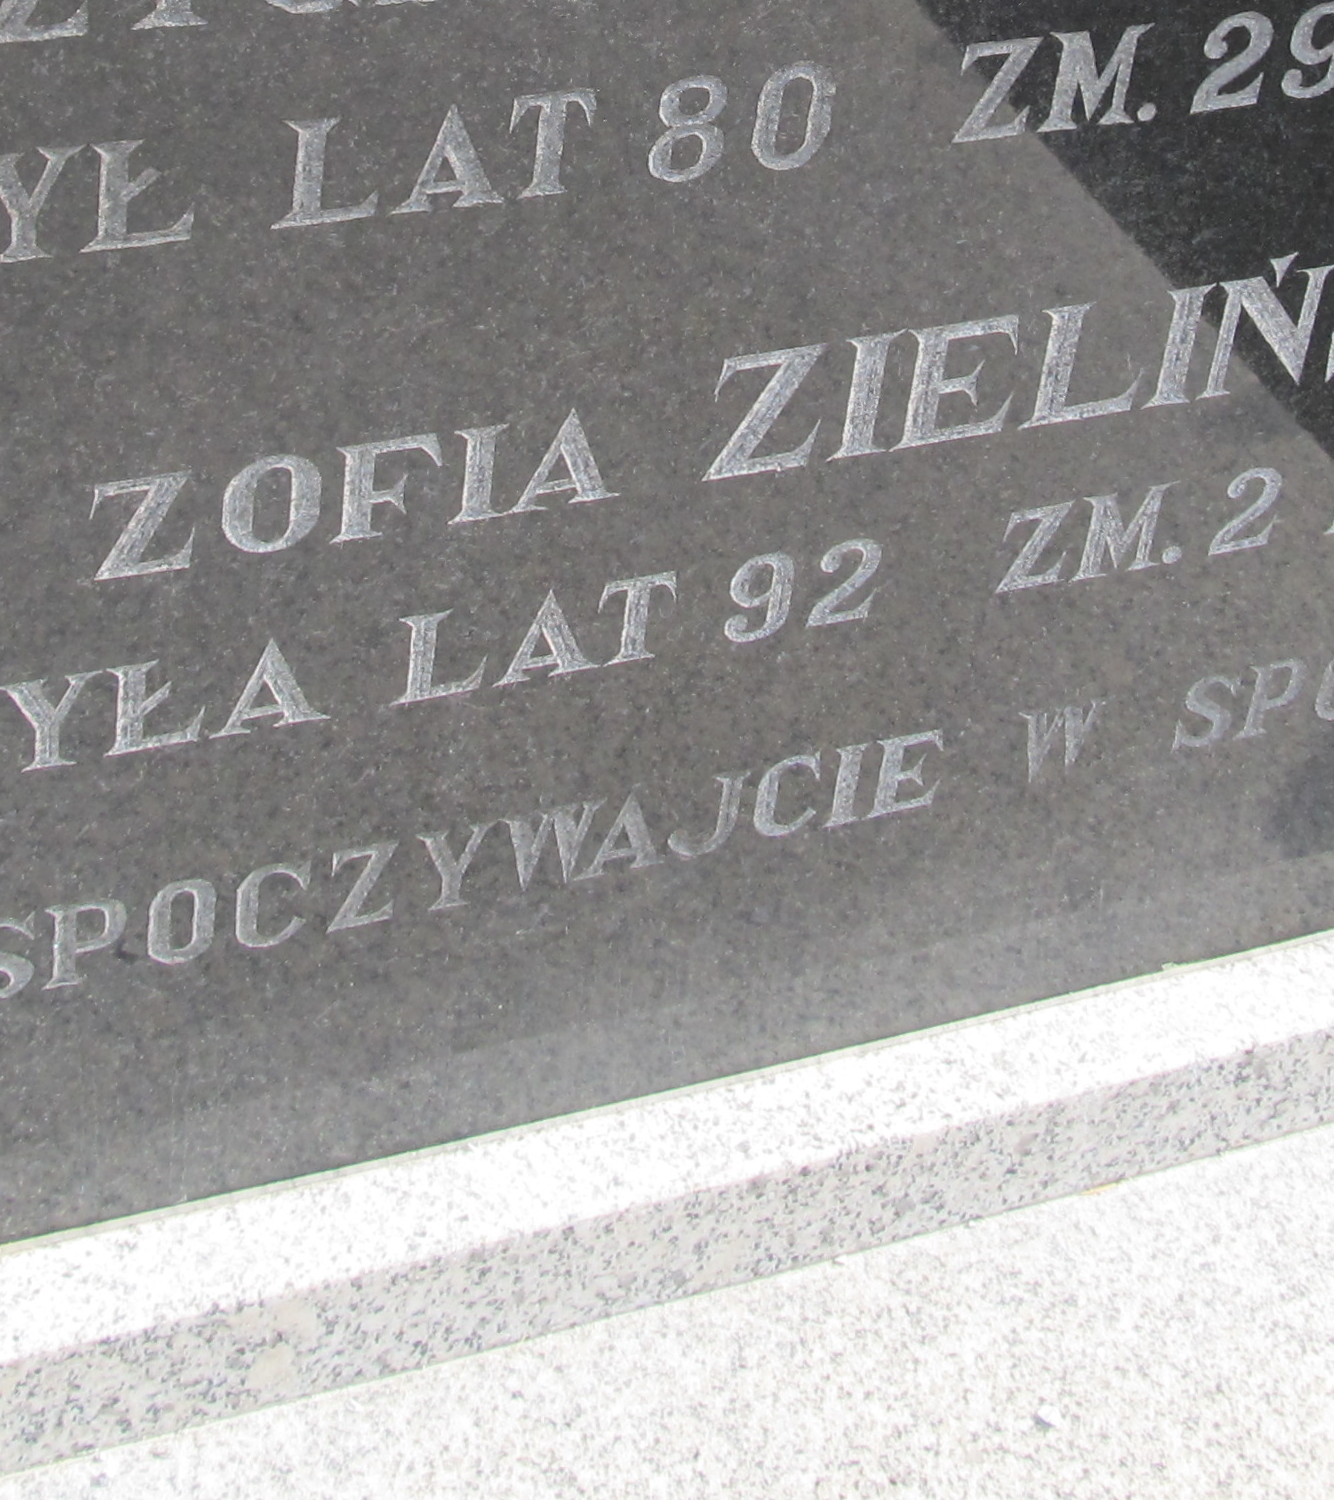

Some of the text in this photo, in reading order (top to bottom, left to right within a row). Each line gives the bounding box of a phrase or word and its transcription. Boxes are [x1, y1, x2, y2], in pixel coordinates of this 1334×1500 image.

[271, 86, 597, 230] LAT
[648, 59, 837, 183] 80
[951, 23, 1157, 144] ZM.
[89, 407, 620, 581] ZOFIA
[391, 571, 678, 706] LAT
[723, 538, 884, 643] 92
[994, 481, 1182, 595] ZM.
[1208, 466, 1283, 557] 2
[1017, 700, 1104, 784] W
